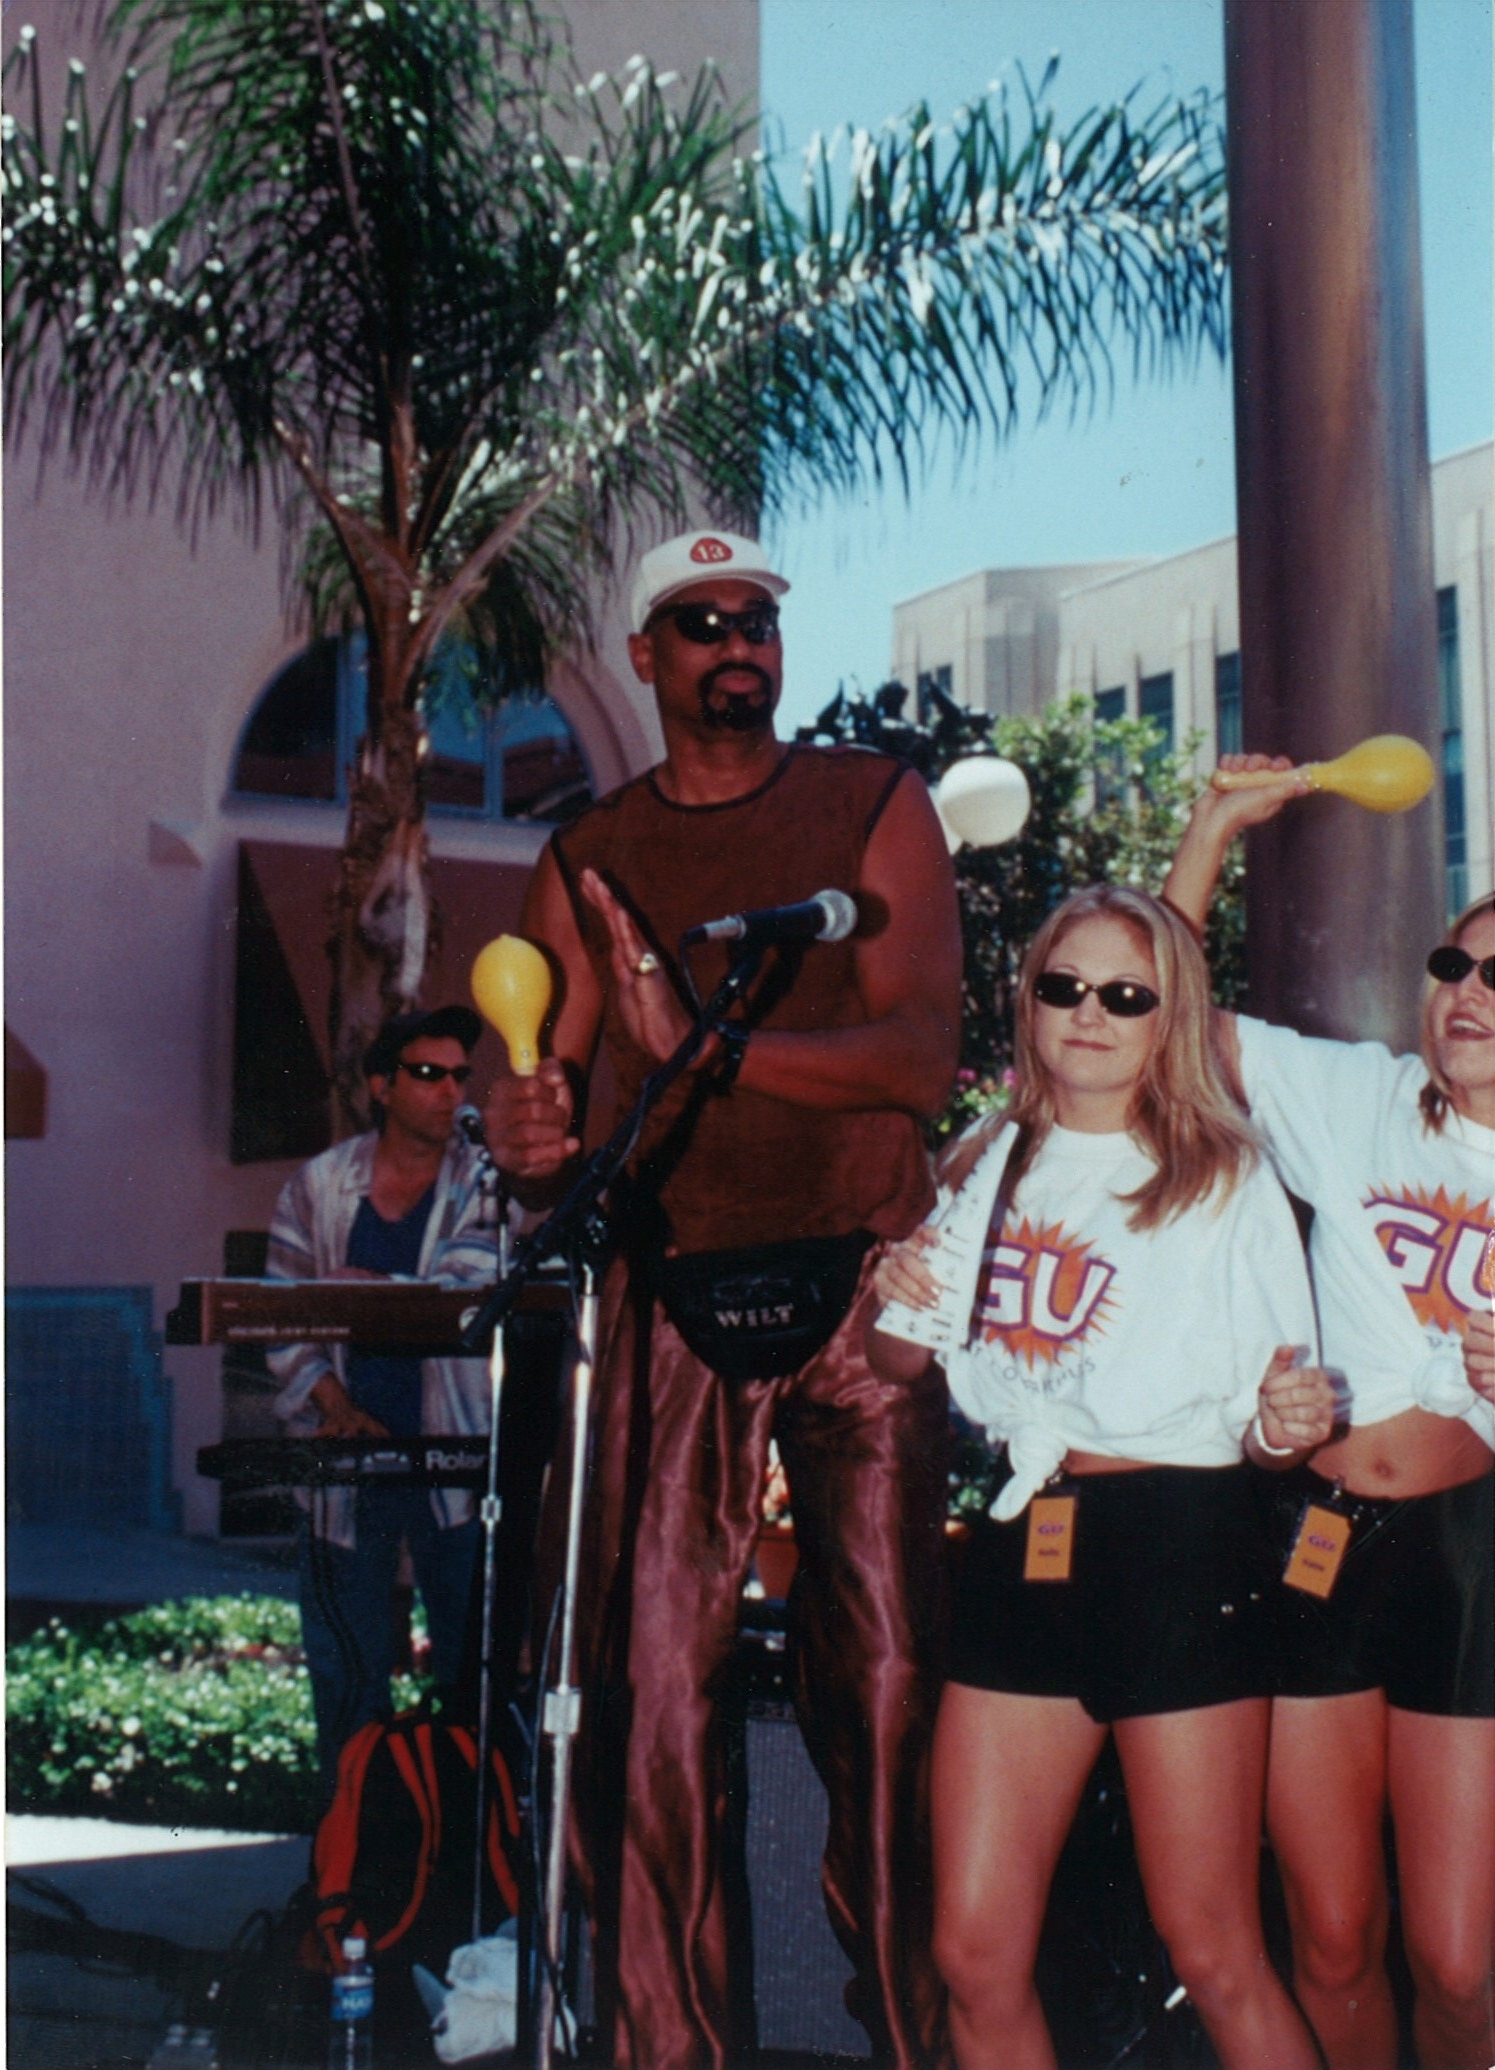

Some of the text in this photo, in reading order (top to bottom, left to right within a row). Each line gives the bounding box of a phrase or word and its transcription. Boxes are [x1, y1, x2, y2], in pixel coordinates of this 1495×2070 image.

[699, 544, 725, 561] 13
[1362, 1196, 1495, 1314] GU
[714, 1302, 794, 1328] WILT
